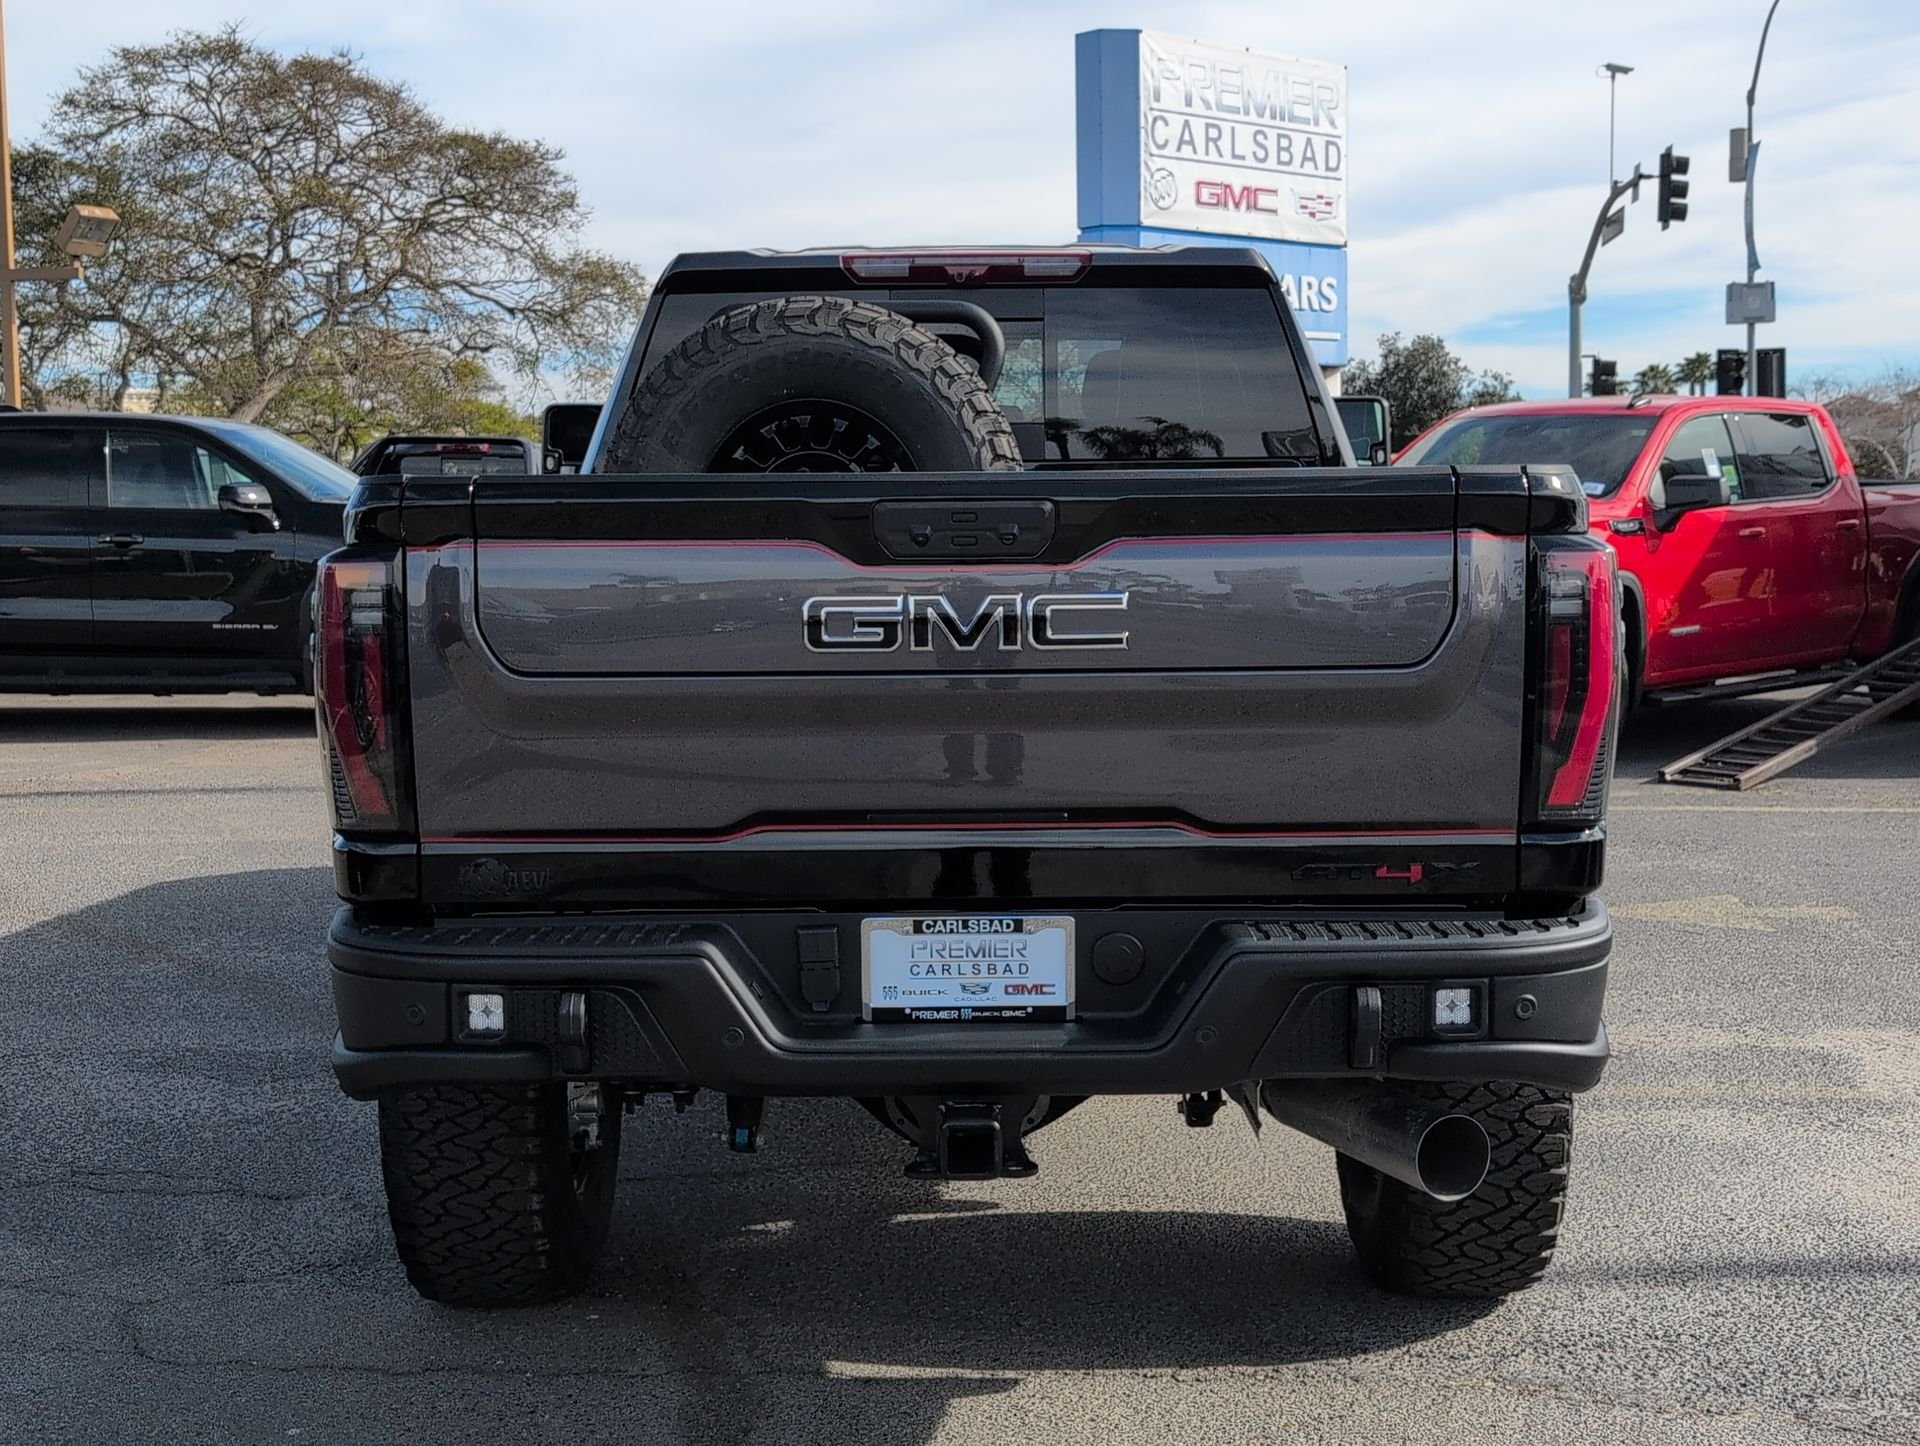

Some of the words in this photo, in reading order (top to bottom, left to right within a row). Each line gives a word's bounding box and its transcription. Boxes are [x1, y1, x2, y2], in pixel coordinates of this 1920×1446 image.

[1152, 55, 1340, 129] PREMIER
[1150, 115, 1342, 173] CARLSBAD
[1194, 180, 1279, 216] GMC
[1280, 273, 1338, 312] ARS
[802, 592, 1128, 652] GMC
[922, 920, 1014, 933] CARLSBAD
[910, 939, 1027, 959] PREMIER
[909, 963, 1029, 976] CARLSBAD
[1003, 984, 1056, 996] GMC
[912, 1010, 959, 1020] PREMIER
